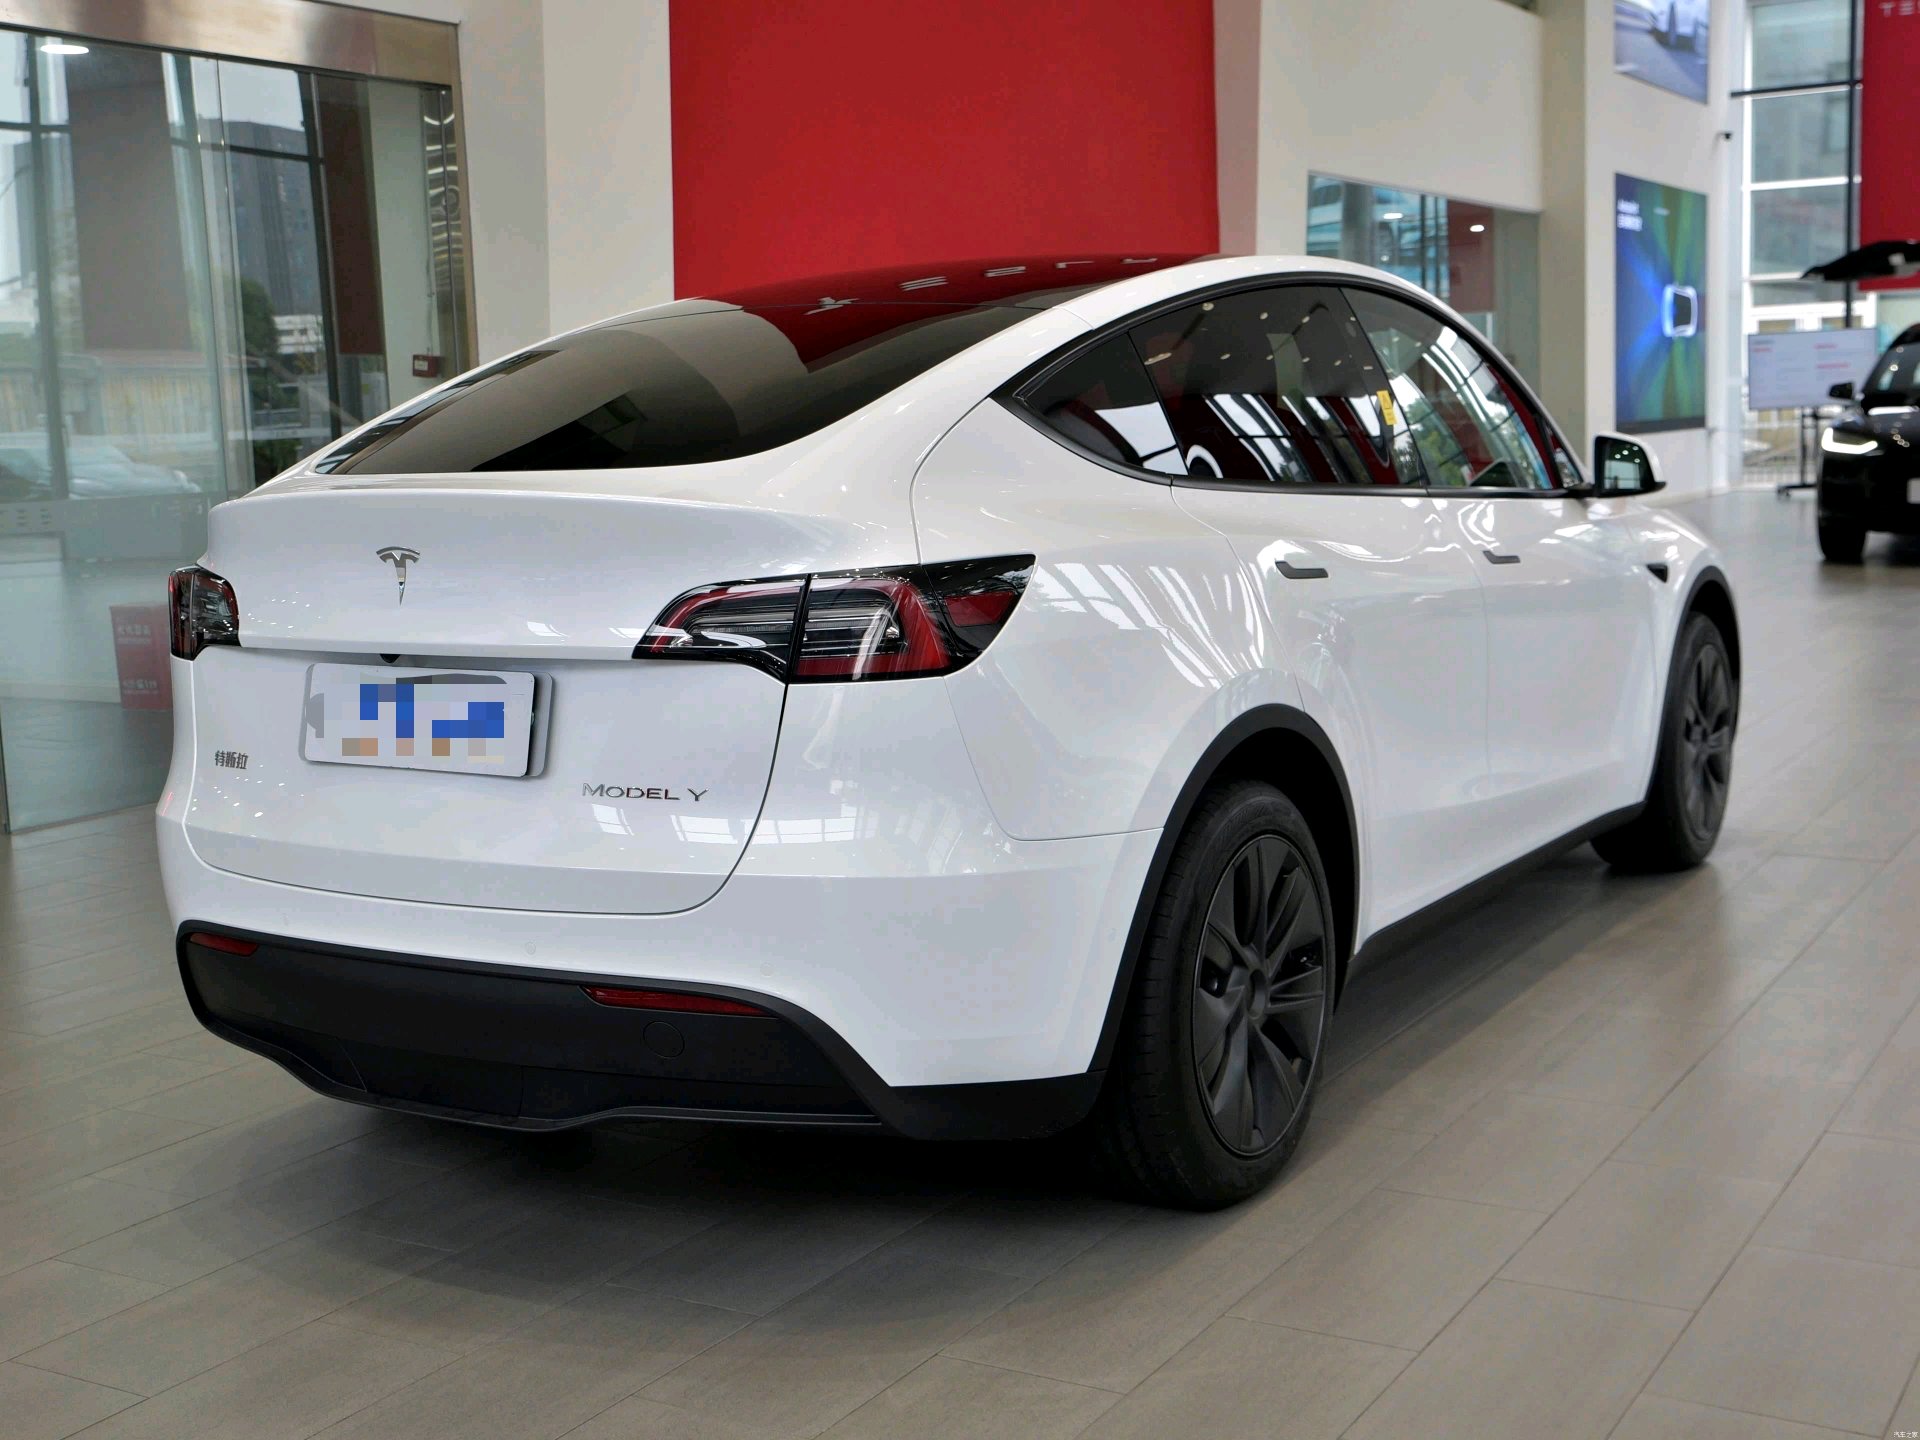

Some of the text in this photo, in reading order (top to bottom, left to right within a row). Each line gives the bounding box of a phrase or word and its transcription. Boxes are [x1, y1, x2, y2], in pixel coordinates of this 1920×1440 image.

[214, 750, 248, 769] 特斯拉
[582, 783, 709, 801] MODEL Y
